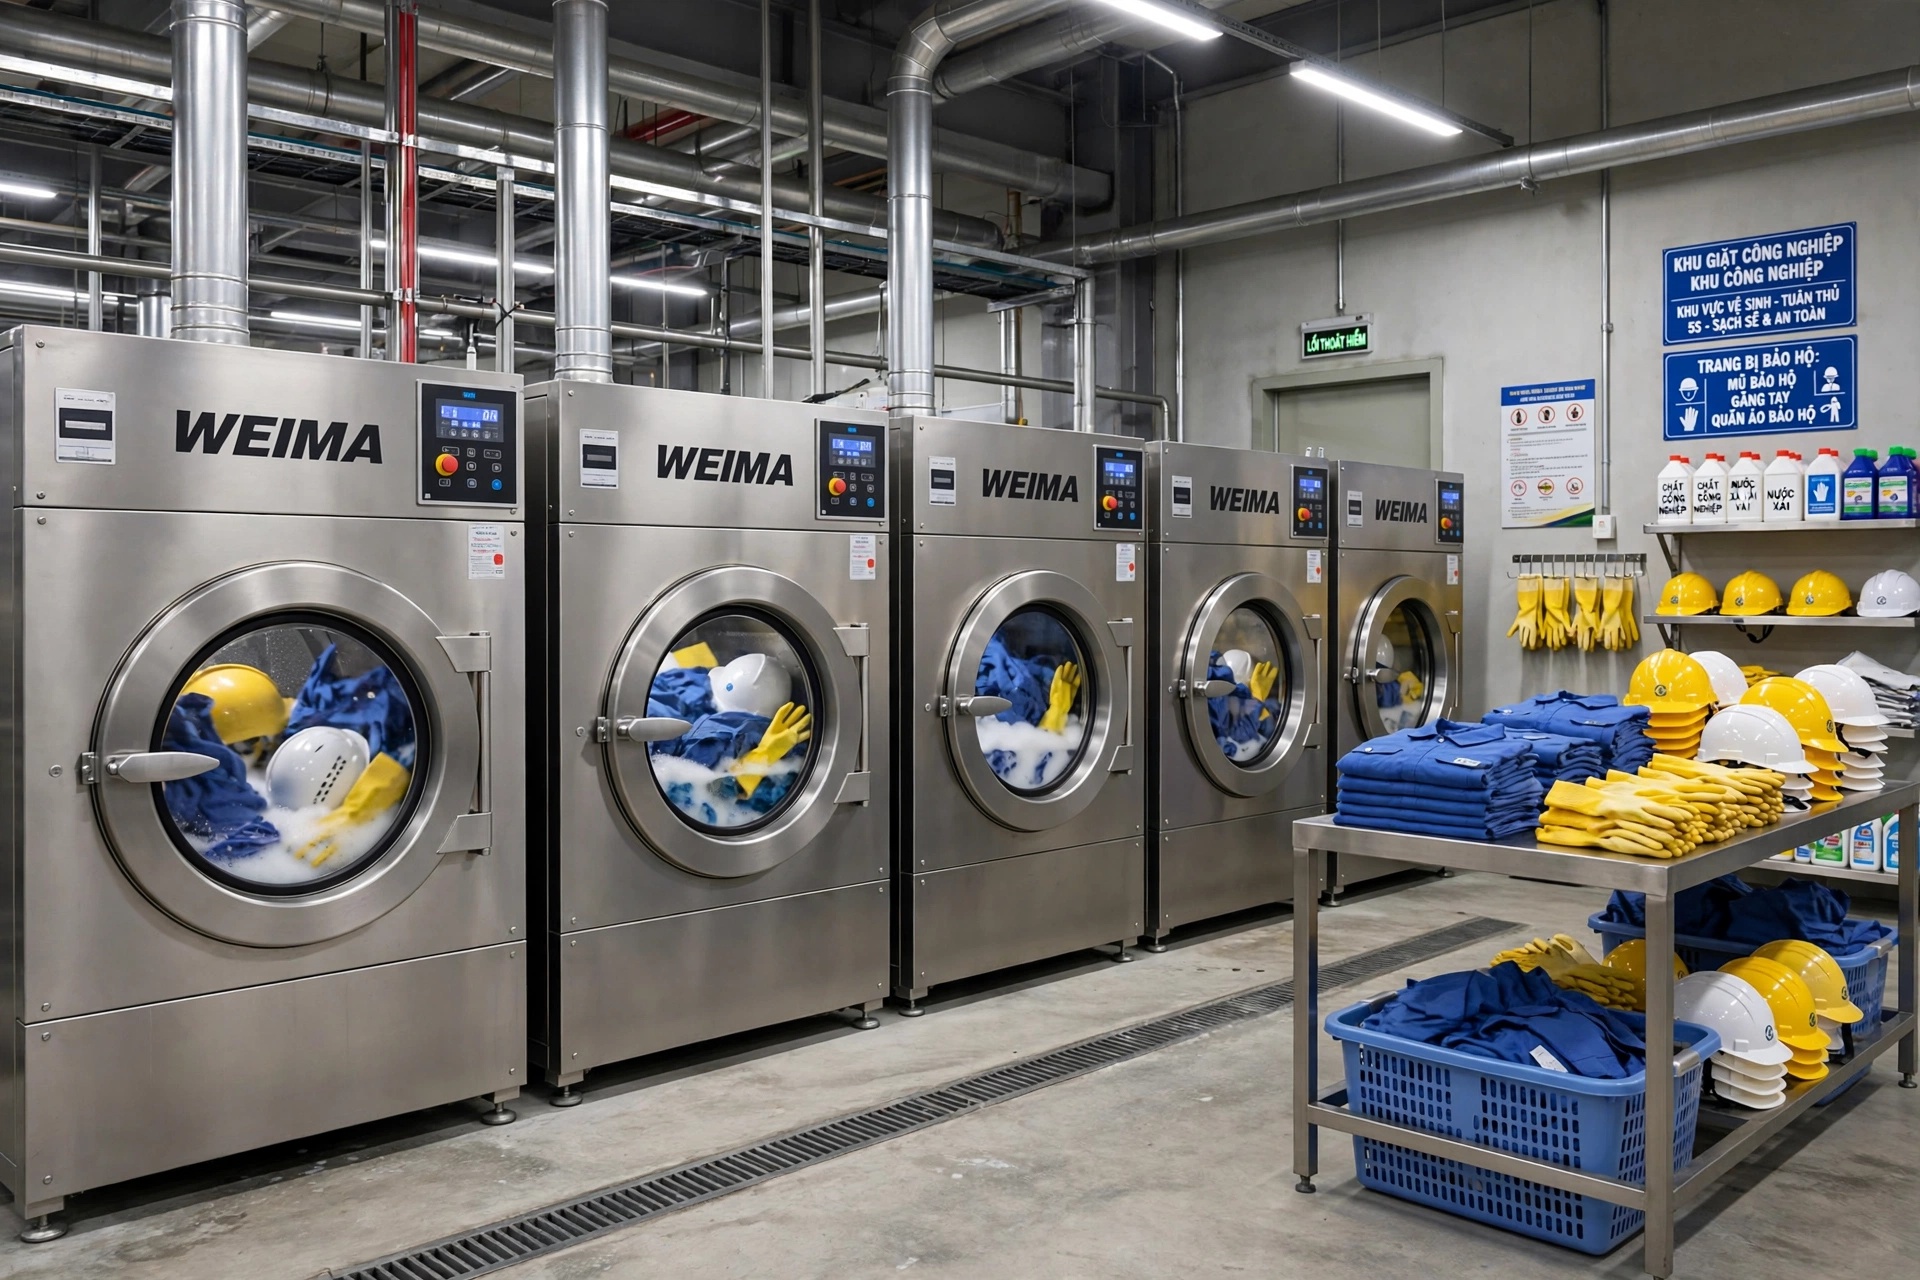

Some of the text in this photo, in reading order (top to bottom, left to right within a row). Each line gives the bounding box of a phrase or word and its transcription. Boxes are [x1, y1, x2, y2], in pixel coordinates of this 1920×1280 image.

[1674, 232, 1843, 272] KHU GIẶT CÔNG NGHIỆP
[1691, 257, 1824, 291] KHU CÔNG NGHIỆP
[1677, 304, 1699, 319] KHU
[1701, 300, 1724, 318] VỰC
[1745, 296, 1771, 311] SINH
[1688, 320, 1702, 334] 5S
[1712, 316, 1742, 334] SẠCH
[1762, 313, 1771, 326] &
[1774, 311, 1791, 325] AN
[1793, 305, 1826, 322] TOÀN
[1697, 356, 1741, 374] TRANG
[1745, 355, 1758, 373] BỊ
[1795, 346, 1820, 368] HỘ:
[1779, 369, 1797, 389] HỘ
[1768, 391, 1790, 405] TAY
[1798, 405, 1816, 424] HỘ
[176, 409, 383, 464] WEIMA
[657, 444, 794, 486] WEIMA
[982, 468, 1079, 502] WEIMA
[1210, 485, 1280, 514] WEIMA
[1375, 499, 1428, 523] WEIMA
